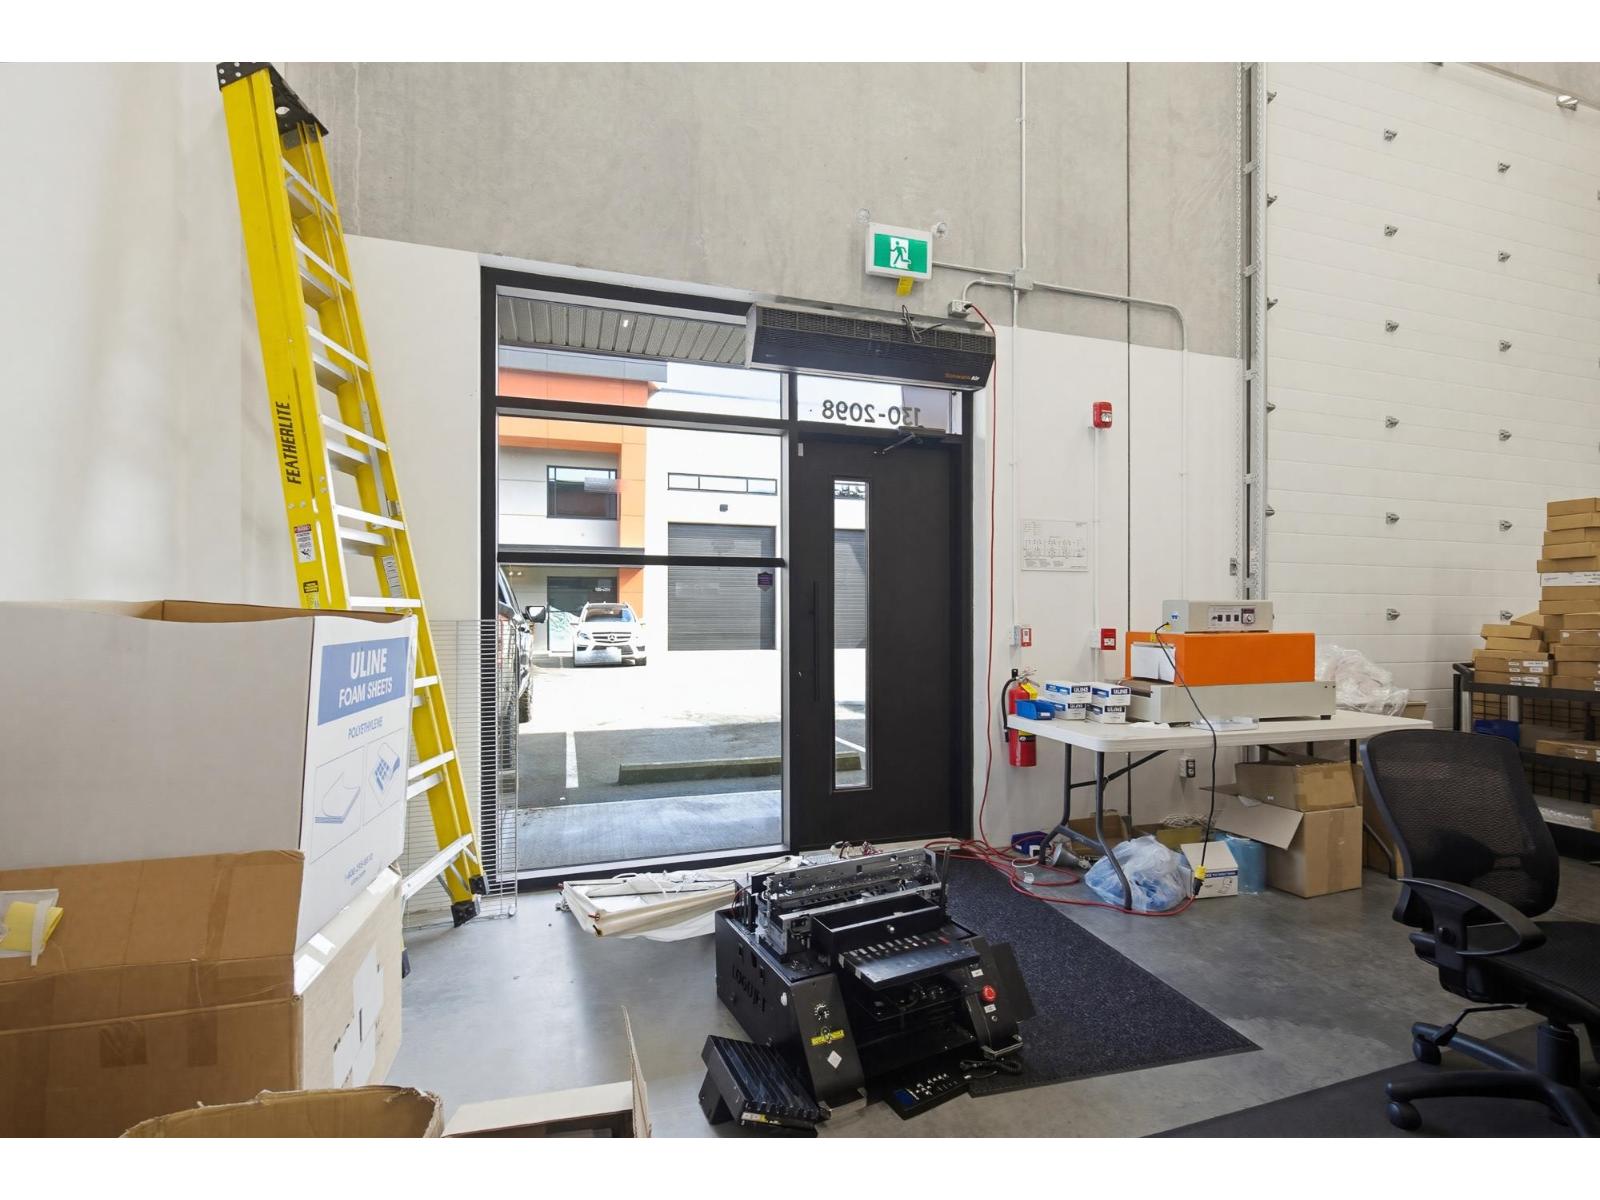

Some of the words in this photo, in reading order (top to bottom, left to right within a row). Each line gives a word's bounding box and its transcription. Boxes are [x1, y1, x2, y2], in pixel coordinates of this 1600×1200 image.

[275, 401, 302, 485] FEATHERLITE
[350, 647, 388, 680] ULINE
[338, 683, 366, 709] FOAM
[367, 676, 393, 699] SHEETS
